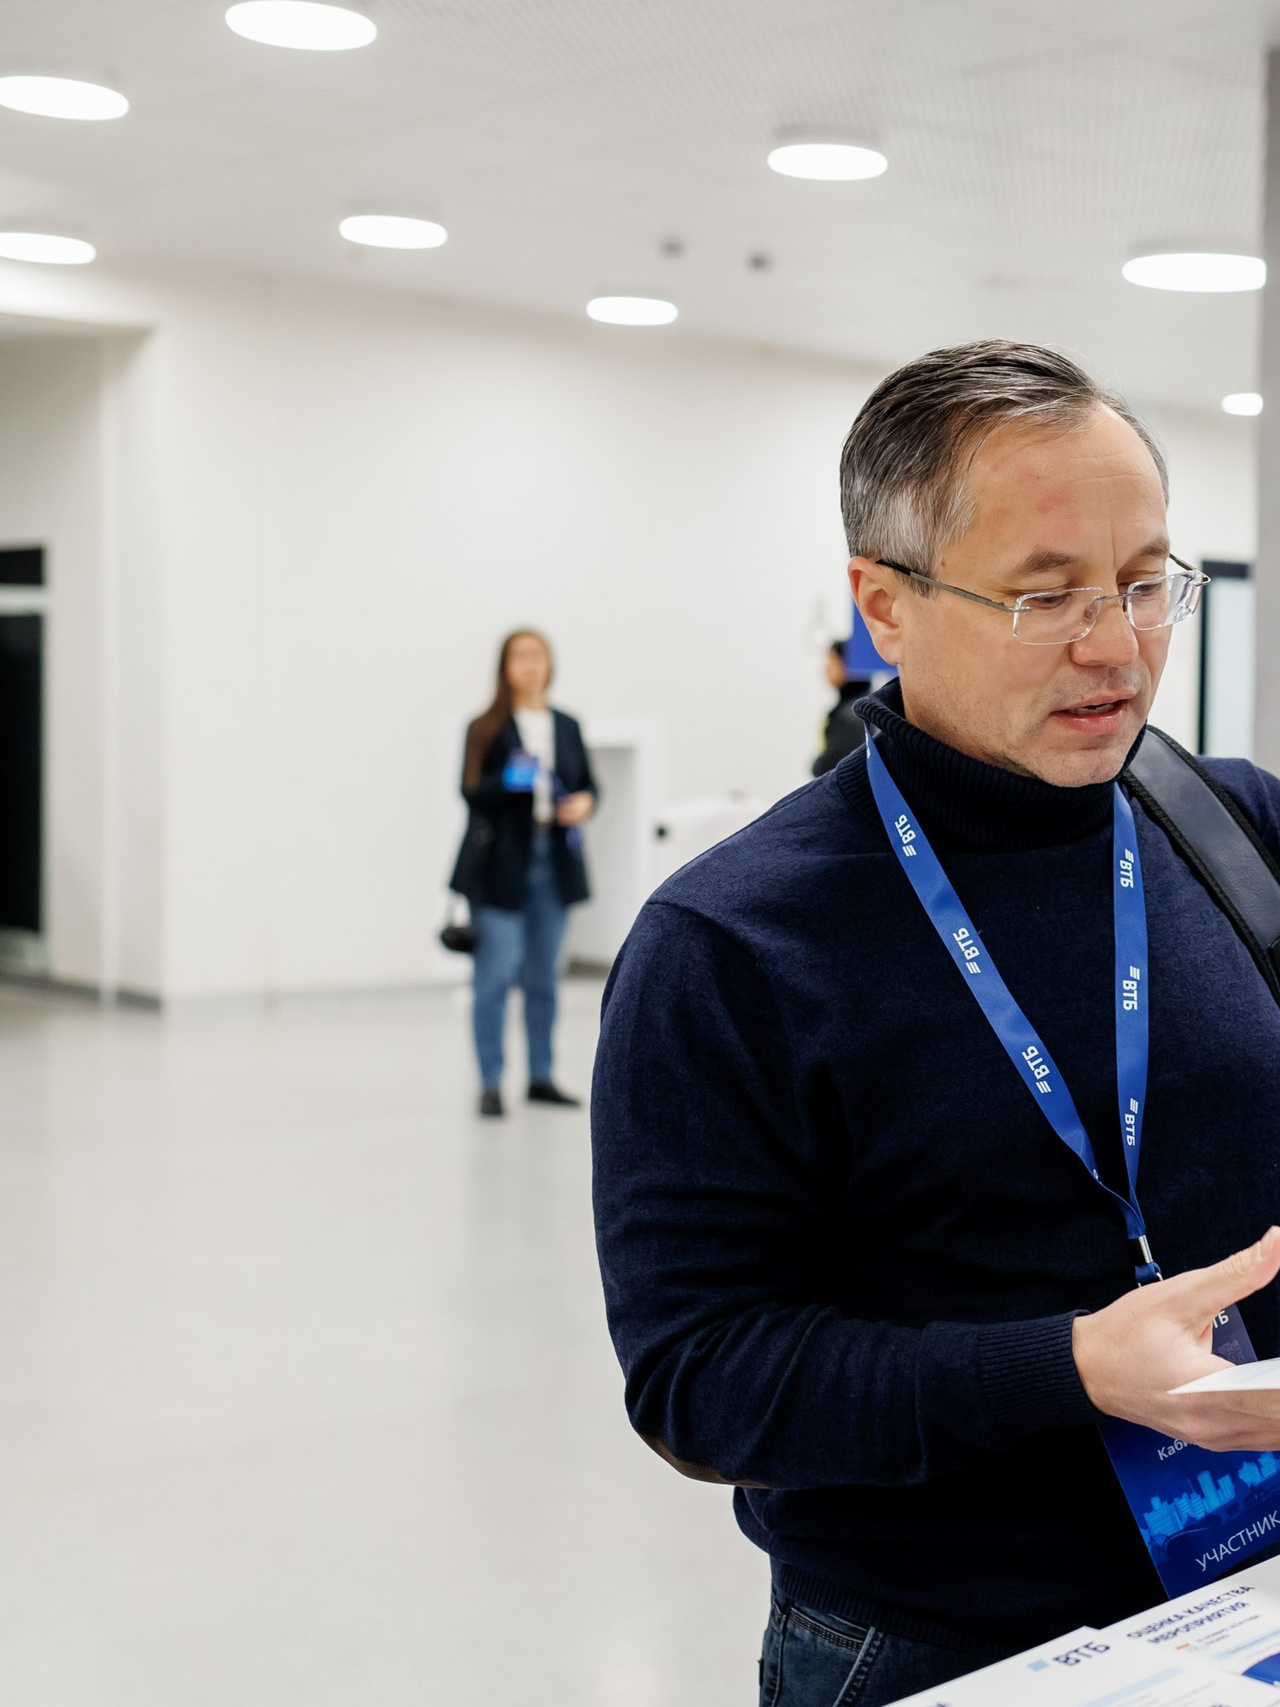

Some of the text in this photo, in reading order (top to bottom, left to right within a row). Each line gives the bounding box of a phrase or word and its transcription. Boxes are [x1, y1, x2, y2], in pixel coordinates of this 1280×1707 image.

[894, 814, 917, 845] ВТБ
[1119, 859, 1134, 889] ВТБ
[953, 927, 981, 961] ВТБ
[1122, 979, 1138, 1011] ВТБ
[1021, 1045, 1051, 1080] ВТБ
[1124, 1113, 1136, 1147] ВТБ
[1183, 1585, 1256, 1615] КАЧЕСТВА
[1052, 1640, 1111, 1667] ВТБ
